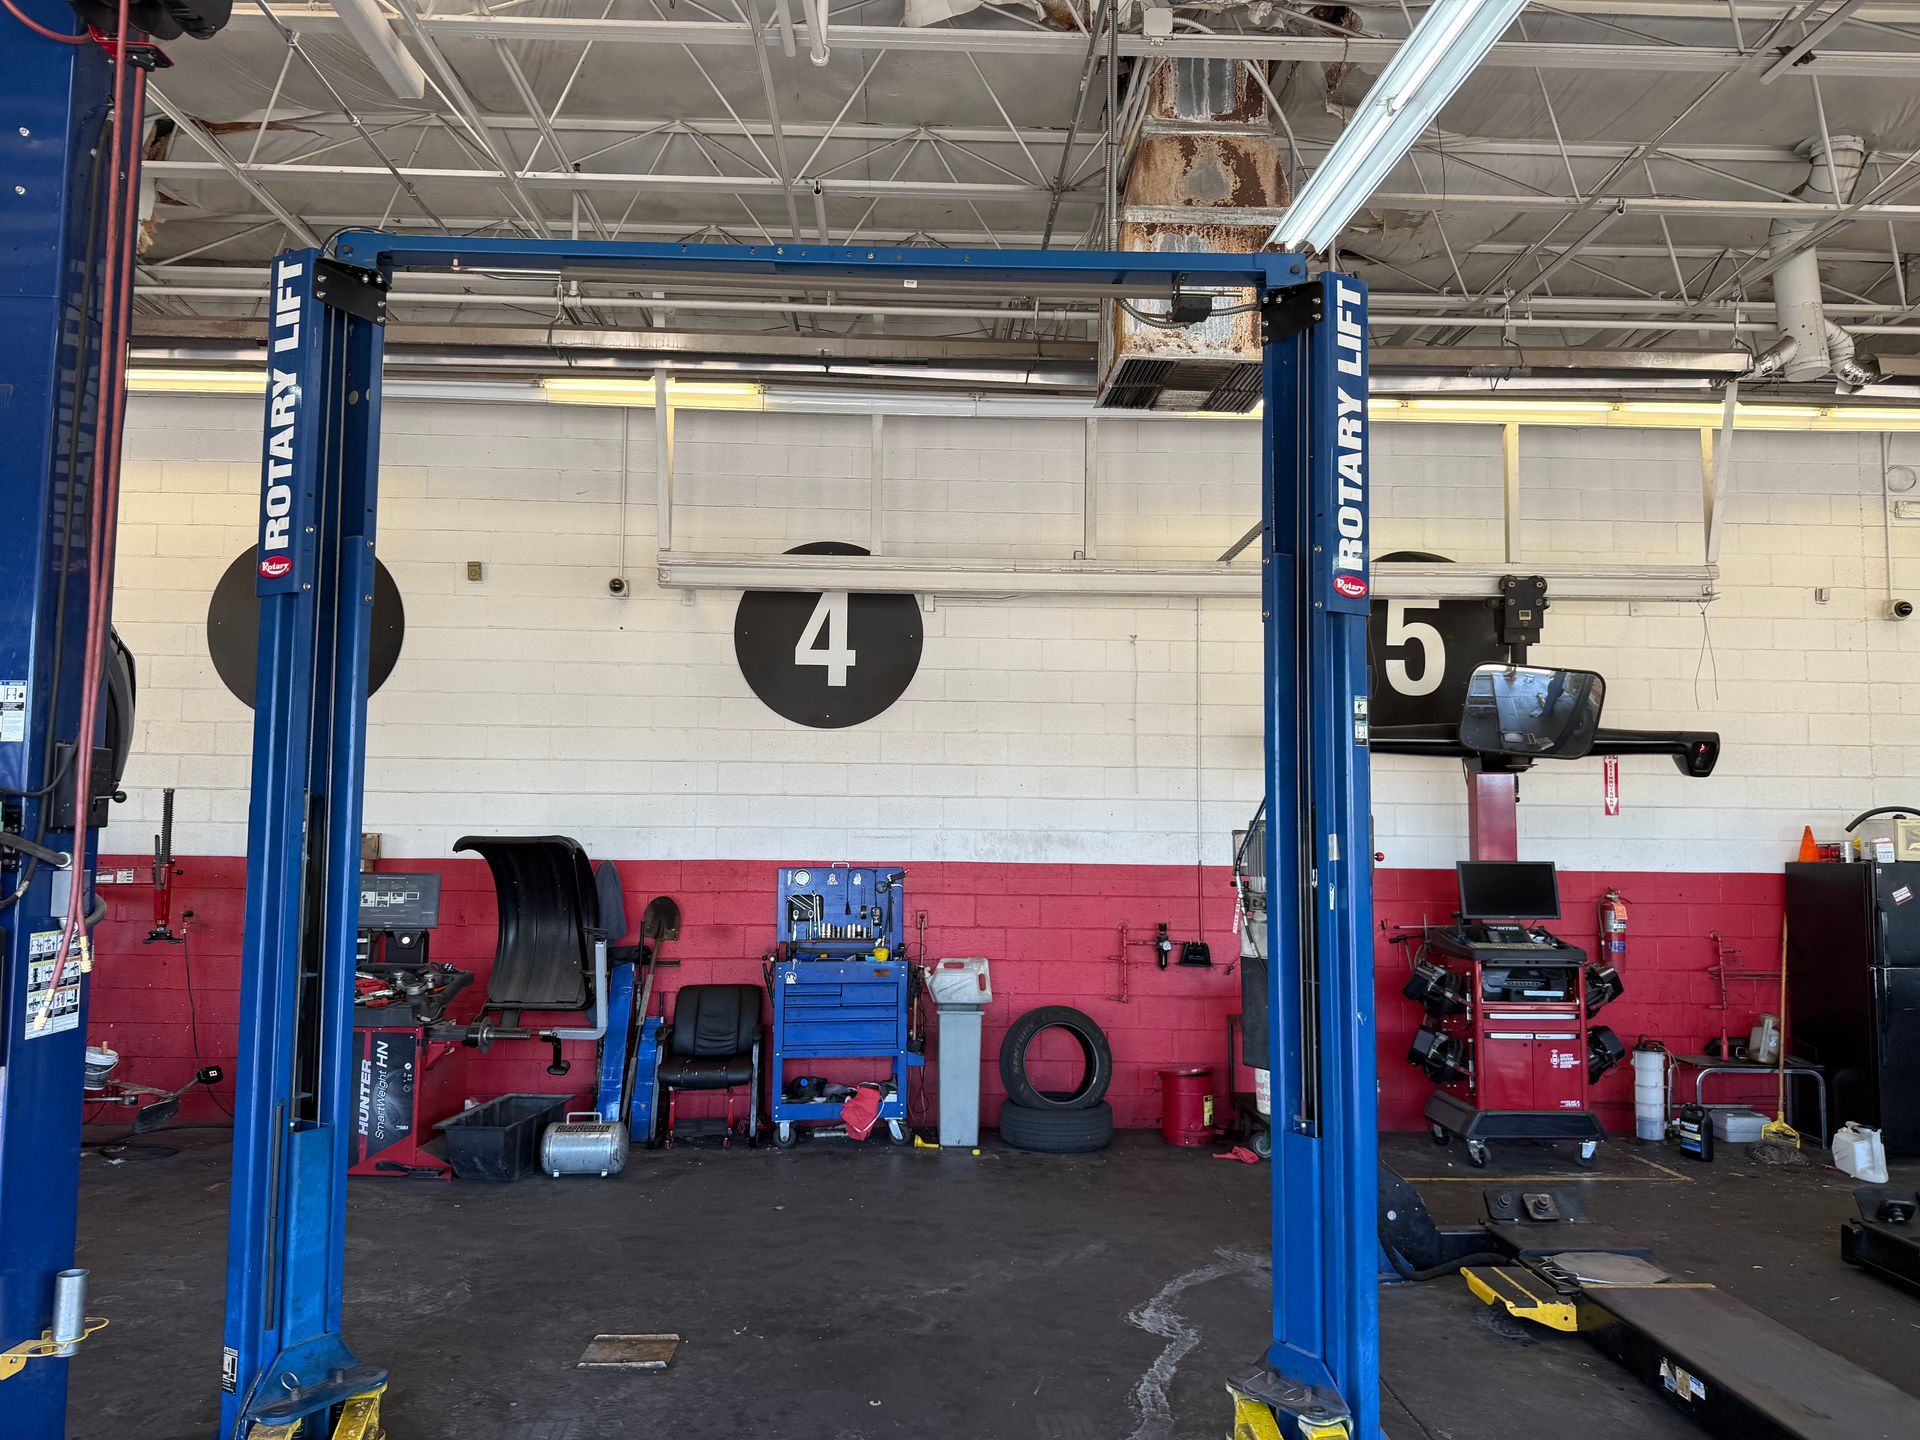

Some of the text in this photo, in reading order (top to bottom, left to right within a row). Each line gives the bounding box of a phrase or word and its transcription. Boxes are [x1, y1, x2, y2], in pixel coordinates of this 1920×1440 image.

[264, 260, 303, 551] ROTARY LIFT
[1337, 280, 1363, 571] ROTARY LIFT
[261, 561, 289, 574] Rotary
[1336, 578, 1365, 593] Rotary
[794, 591, 856, 687] 4
[1384, 599, 1446, 697] 5
[358, 1058, 372, 1136] HUNTER
[374, 1040, 389, 1140] SmartWeight HN
